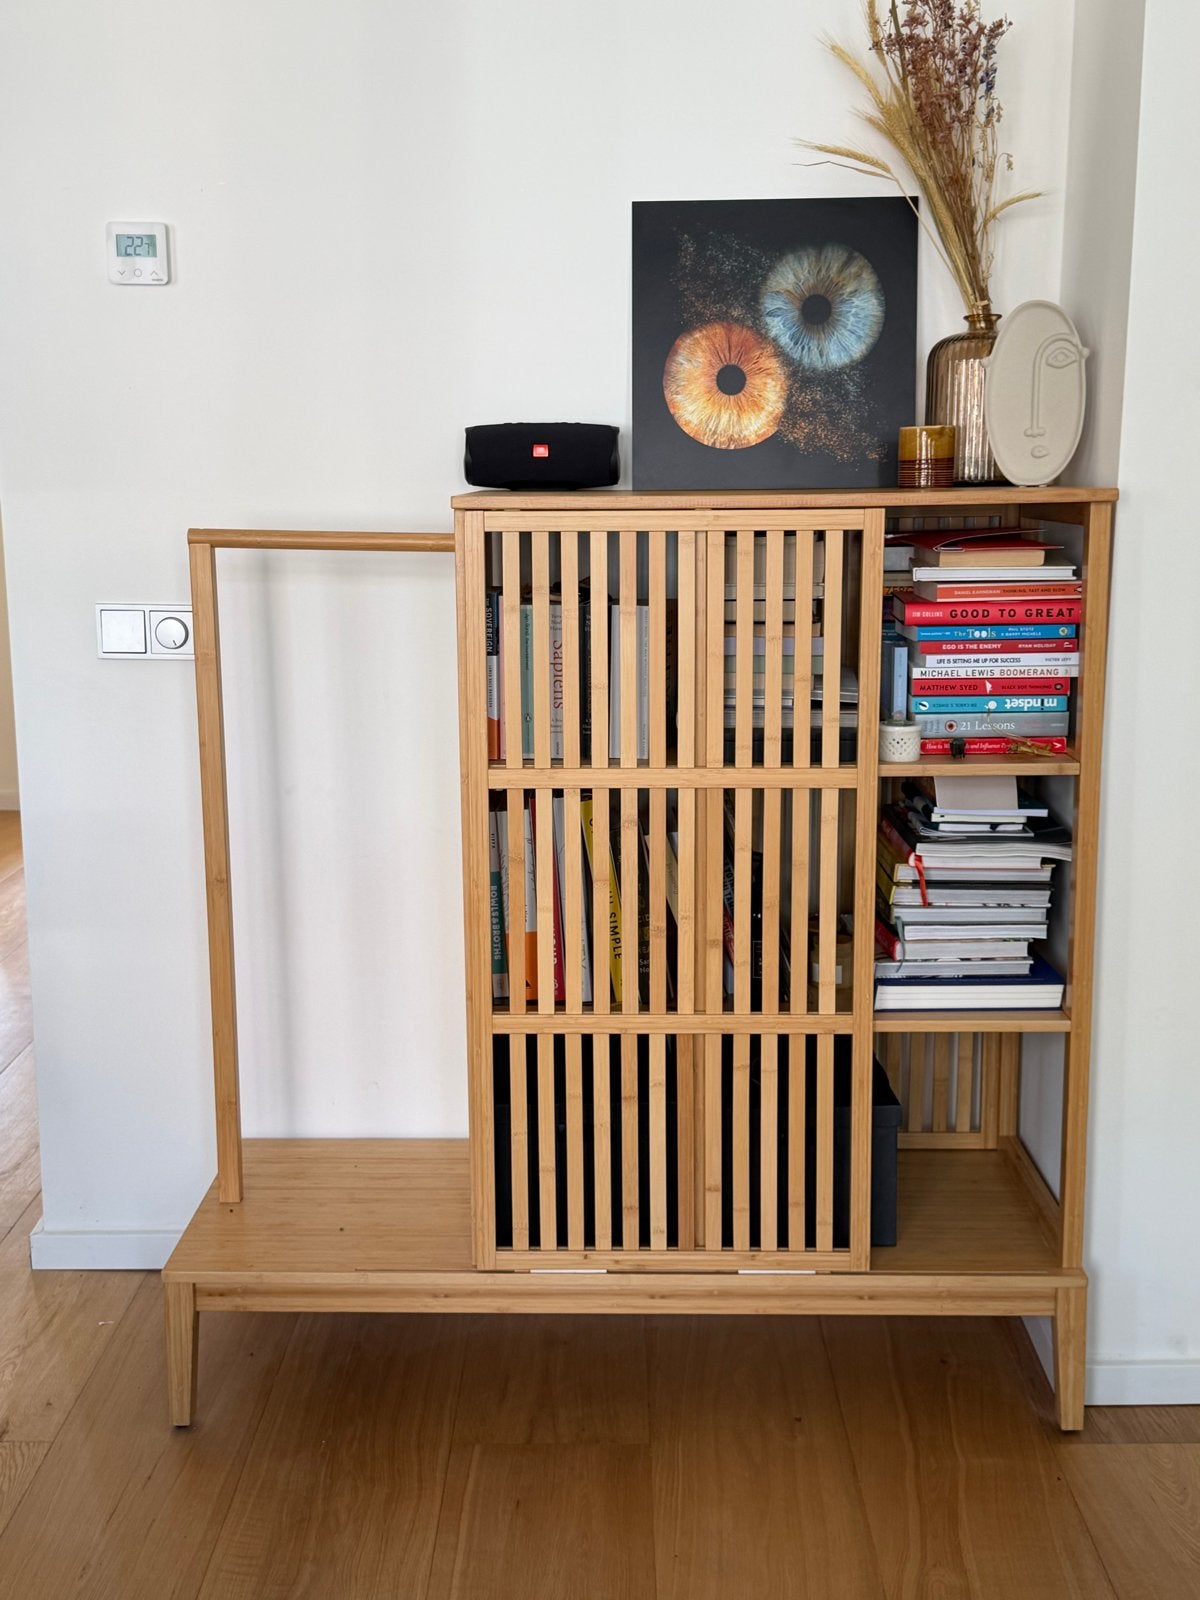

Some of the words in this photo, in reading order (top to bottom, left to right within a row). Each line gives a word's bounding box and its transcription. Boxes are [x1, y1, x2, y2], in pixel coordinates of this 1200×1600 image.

[950, 609, 990, 619] GOOD
[999, 608, 1017, 618] TO
[1025, 607, 1074, 618] GREAT
[966, 628, 997, 639] Tools
[550, 640, 563, 709] Sapiens
[920, 669, 961, 678] MICHAEL
[966, 668, 995, 677] LEWIS
[999, 668, 1059, 677] BOOMERANG
[1005, 698, 1057, 711] mindset
[960, 721, 971, 731] 21
[975, 720, 1016, 731] Lessons
[610, 912, 622, 960] SIMPLE
